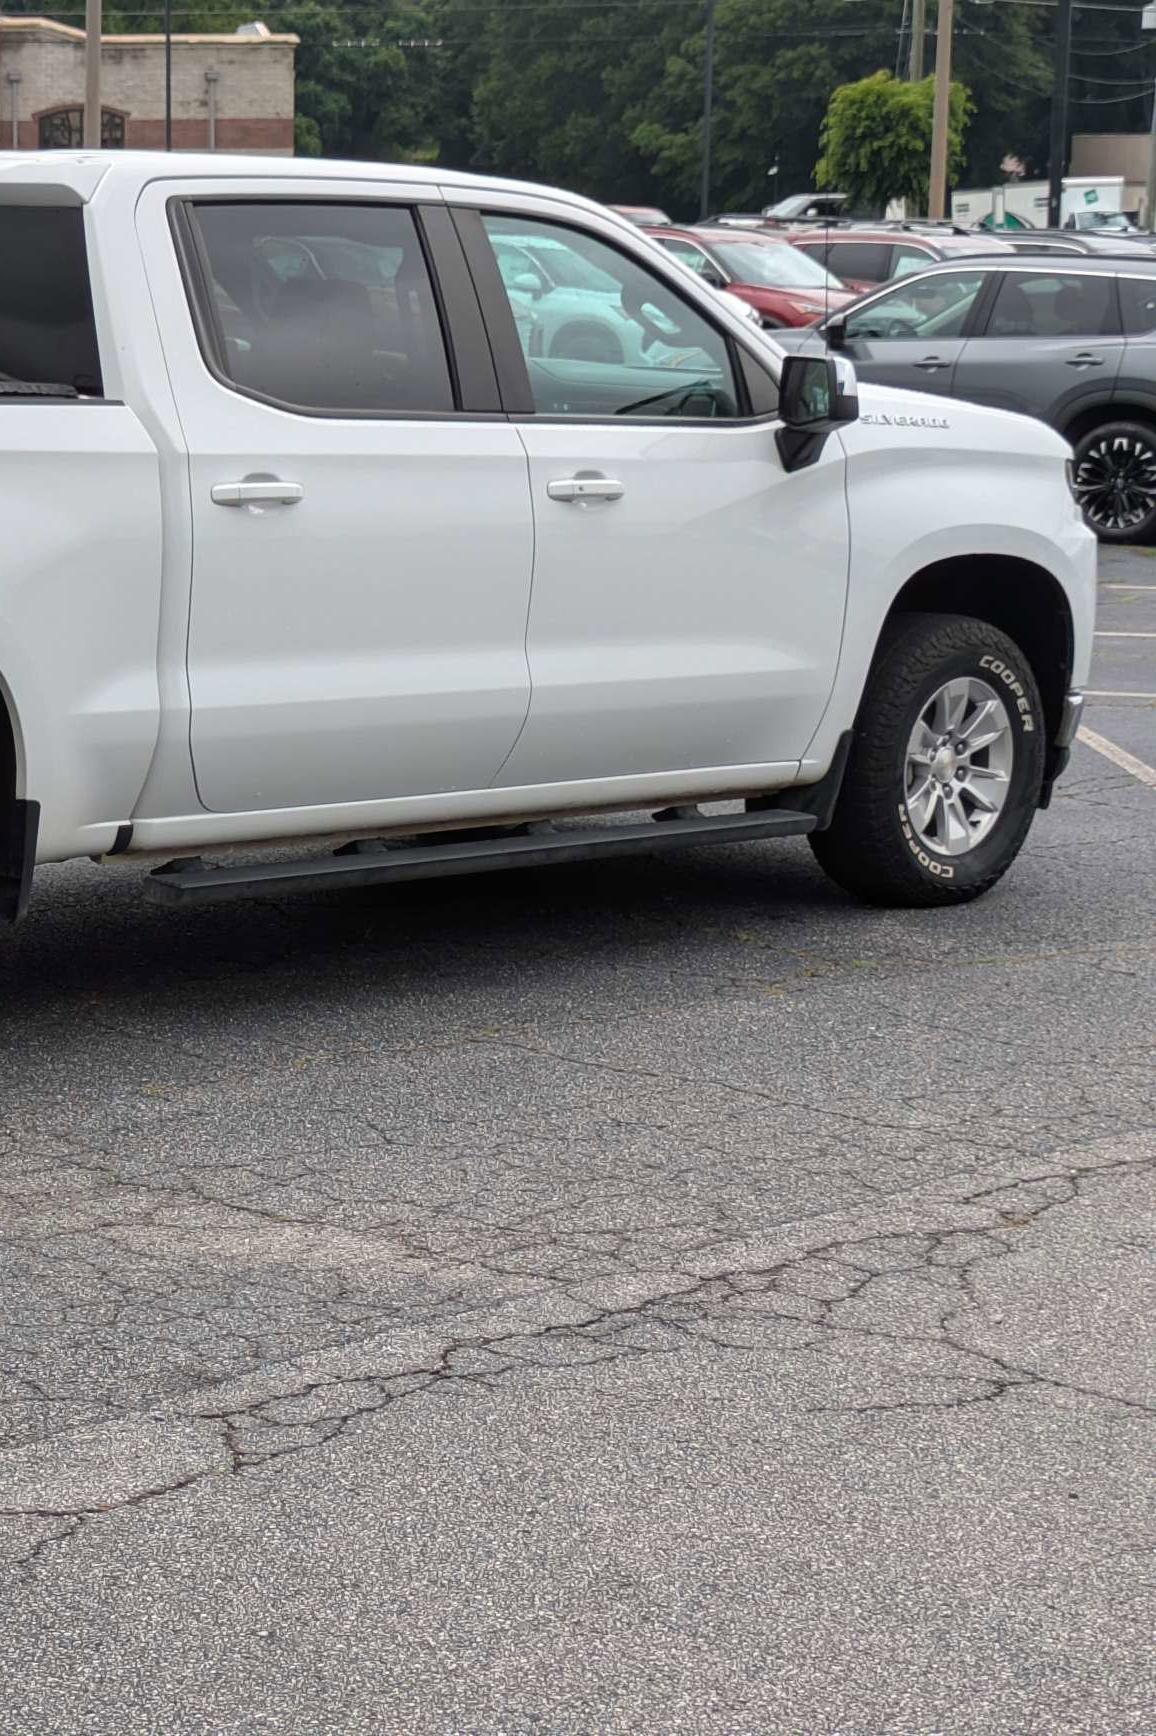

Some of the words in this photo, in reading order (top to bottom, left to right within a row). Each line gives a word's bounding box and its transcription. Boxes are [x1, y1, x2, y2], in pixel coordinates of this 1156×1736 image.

[860, 414, 950, 429] SILVERADO
[979, 655, 1034, 732] COOPER
[898, 803, 954, 879] COOPER
